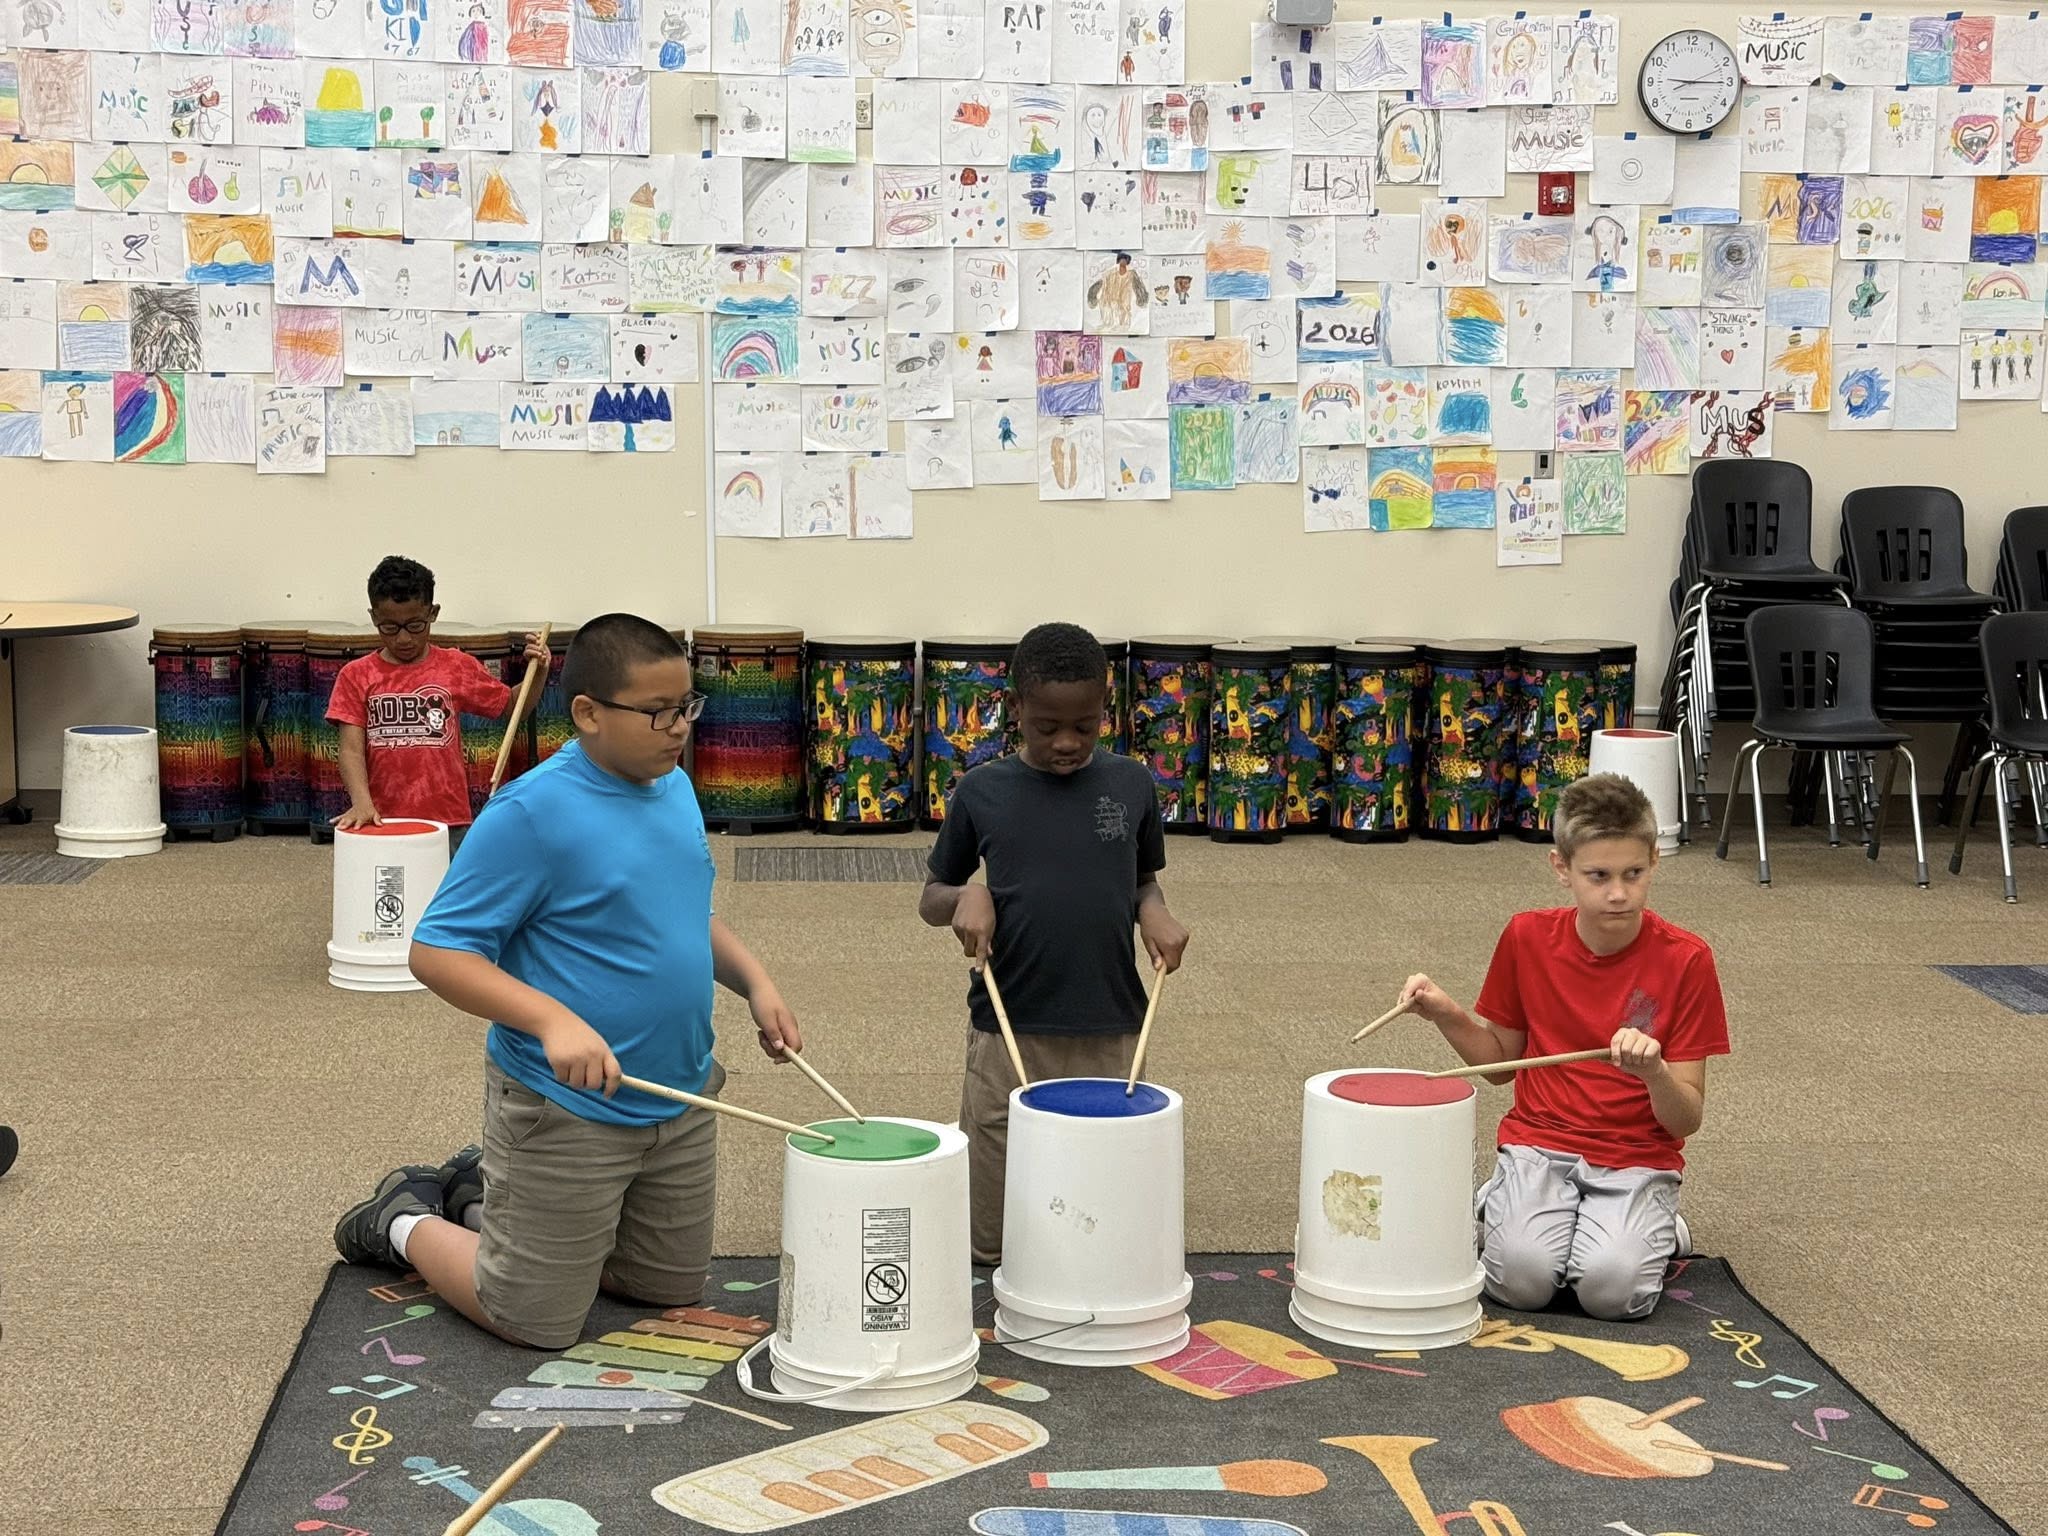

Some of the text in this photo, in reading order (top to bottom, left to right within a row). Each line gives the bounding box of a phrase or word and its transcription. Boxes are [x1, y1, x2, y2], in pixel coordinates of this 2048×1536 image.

[1004, 4, 1045, 30] RAP
[1687, 36, 1698, 45] 12
[1665, 43, 1676, 51] 11
[1709, 43, 1714, 51] 1
[1651, 57, 1662, 66] 10
[1723, 57, 1730, 66] 2
[1647, 77, 1654, 86] 9
[1727, 77, 1734, 86] 3
[1652, 99, 1659, 107] 8
[1720, 97, 1727, 106] 4
[1665, 114, 1672, 123] 7
[1705, 114, 1713, 123] 5
[1685, 119, 1692, 128] 6
[884, 185, 938, 201] MUSIC
[511, 403, 585, 427] MUSIC
[870, 1314, 894, 1322] AVISO
[864, 1323, 901, 1331] WARNING
